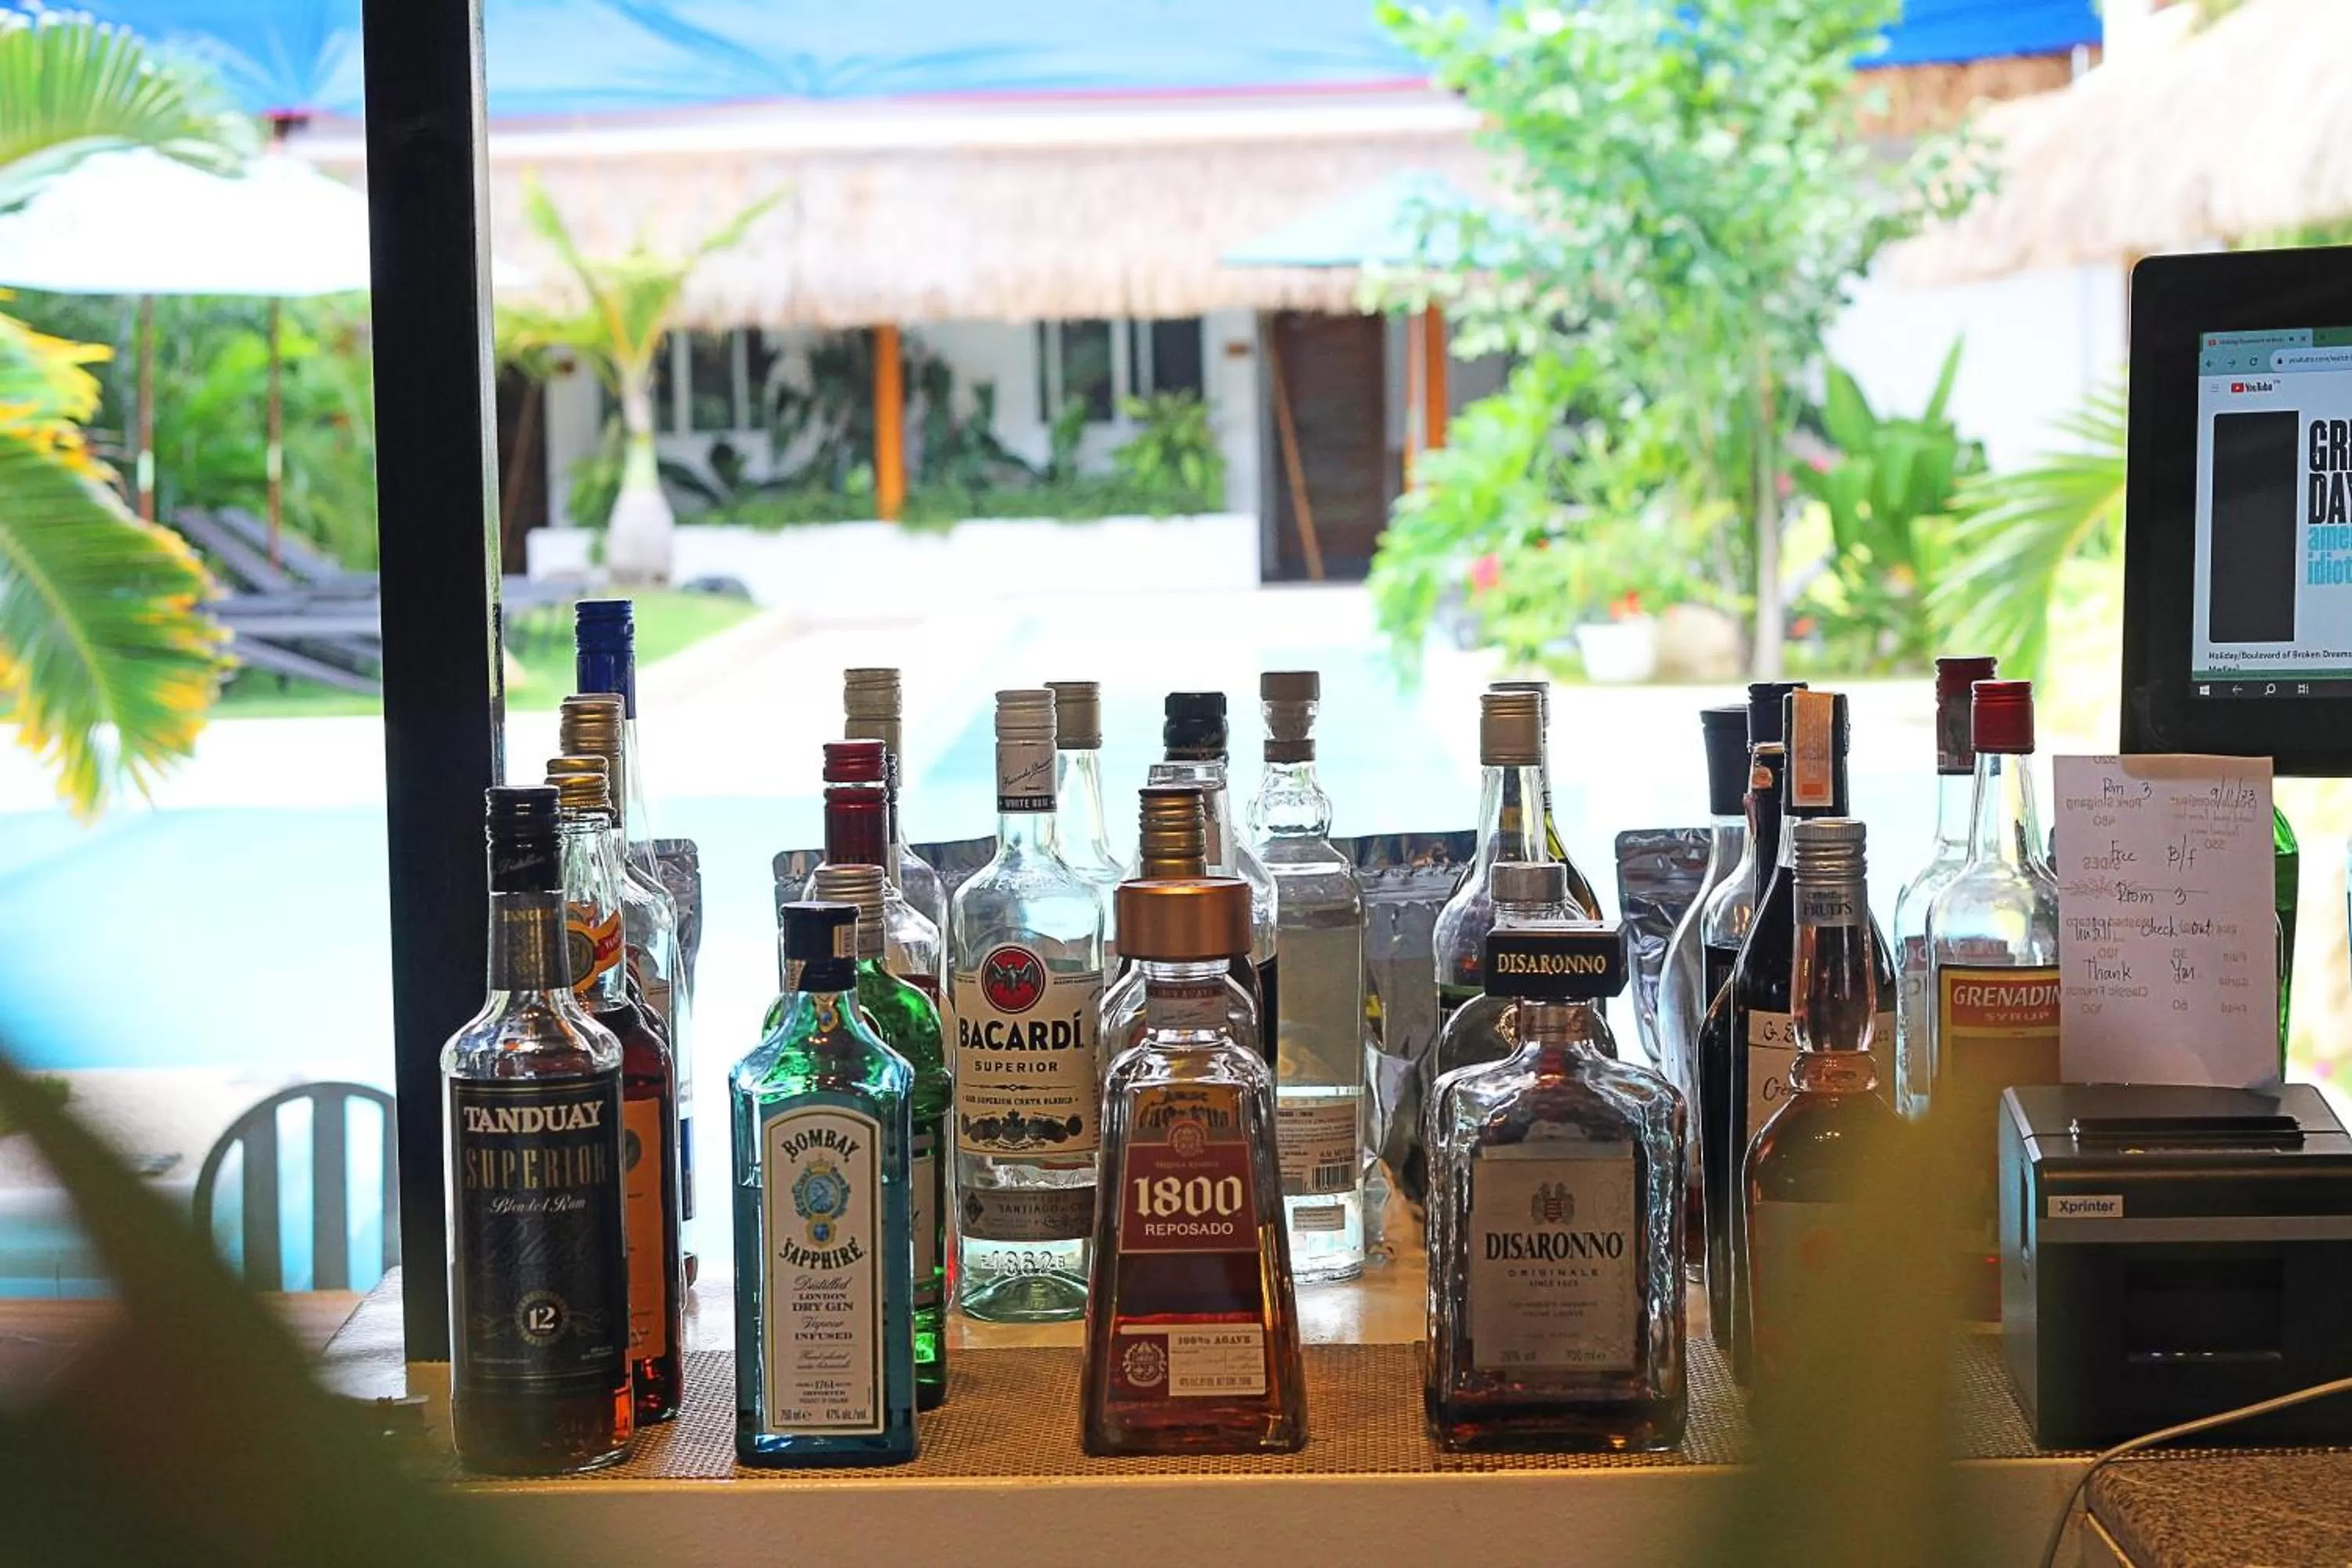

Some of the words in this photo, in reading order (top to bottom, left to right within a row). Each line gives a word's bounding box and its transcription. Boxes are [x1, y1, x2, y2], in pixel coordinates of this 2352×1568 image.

[2245, 382, 2273, 392] YouTube
[2309, 419, 2352, 472] GR
[2292, 650, 2321, 659] Broken
[1802, 901, 1853, 916] FRUITS
[1497, 953, 1606, 975] DISARONNO
[2082, 956, 2132, 981] Thank
[960, 1009, 1082, 1051] BACARDÍ
[975, 1061, 1058, 1073] SUPERIOR
[464, 1101, 603, 1133] TANDUAY
[782, 1129, 861, 1163] BOMBAY
[466, 1142, 607, 1190] SUPERIOR
[490, 1196, 551, 1214] Blended
[550, 1193, 586, 1212] Rum
[1133, 1176, 1243, 1217] 1800
[2059, 1200, 2114, 1214] Xprinter
[1145, 1222, 1233, 1236] REPOSADO
[779, 1236, 864, 1271] SAPPHIRE
[1486, 1232, 1624, 1261] DISARONNO
[793, 1275, 852, 1291] Distilled
[1508, 1269, 1599, 1277] ORIGINALE
[792, 1303, 822, 1312] DRY
[825, 1302, 855, 1312] GIN
[528, 1306, 556, 1330] 12
[1214, 1335, 1252, 1345] AGAVE
